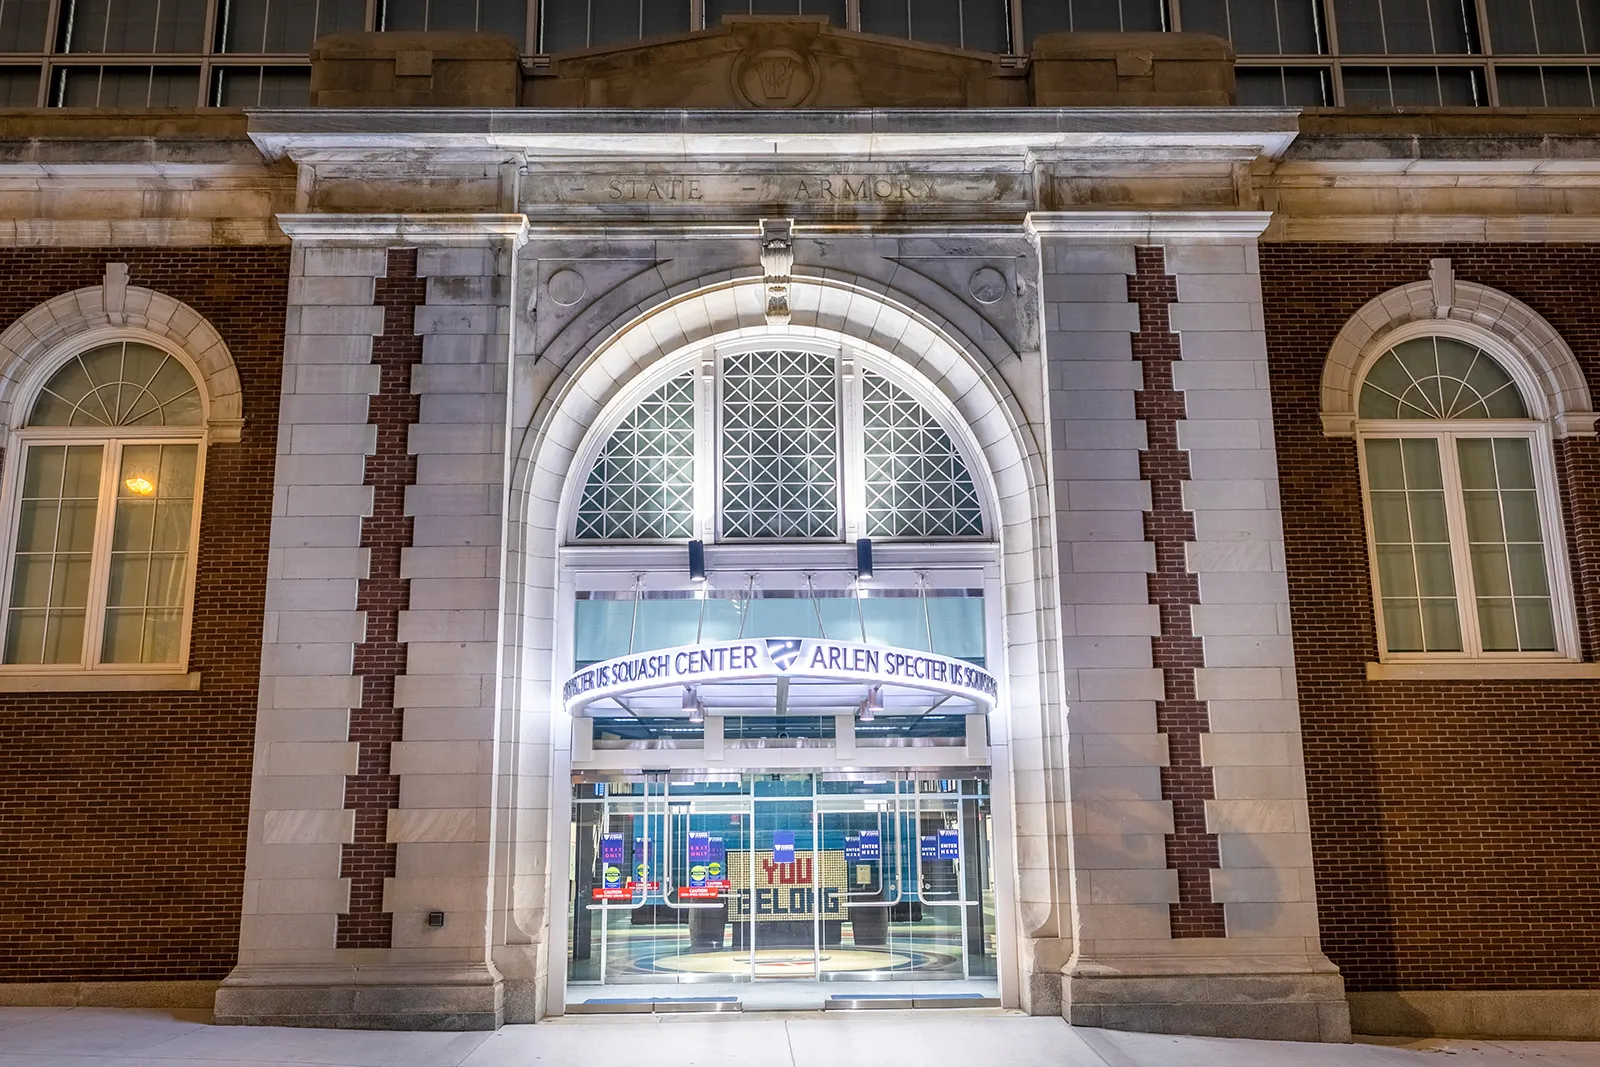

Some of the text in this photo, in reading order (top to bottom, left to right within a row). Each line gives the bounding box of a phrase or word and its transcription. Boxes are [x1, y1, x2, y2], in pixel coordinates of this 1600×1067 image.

[608, 178, 937, 201] STATE ARMORY
[596, 665, 611, 688] US
[611, 654, 671, 684] SQUASH
[674, 645, 758, 676] CENTER
[810, 645, 879, 673] ARLEN
[885, 651, 948, 683] SPECTER
[949, 663, 964, 686] US
[762, 857, 813, 884] YOU
